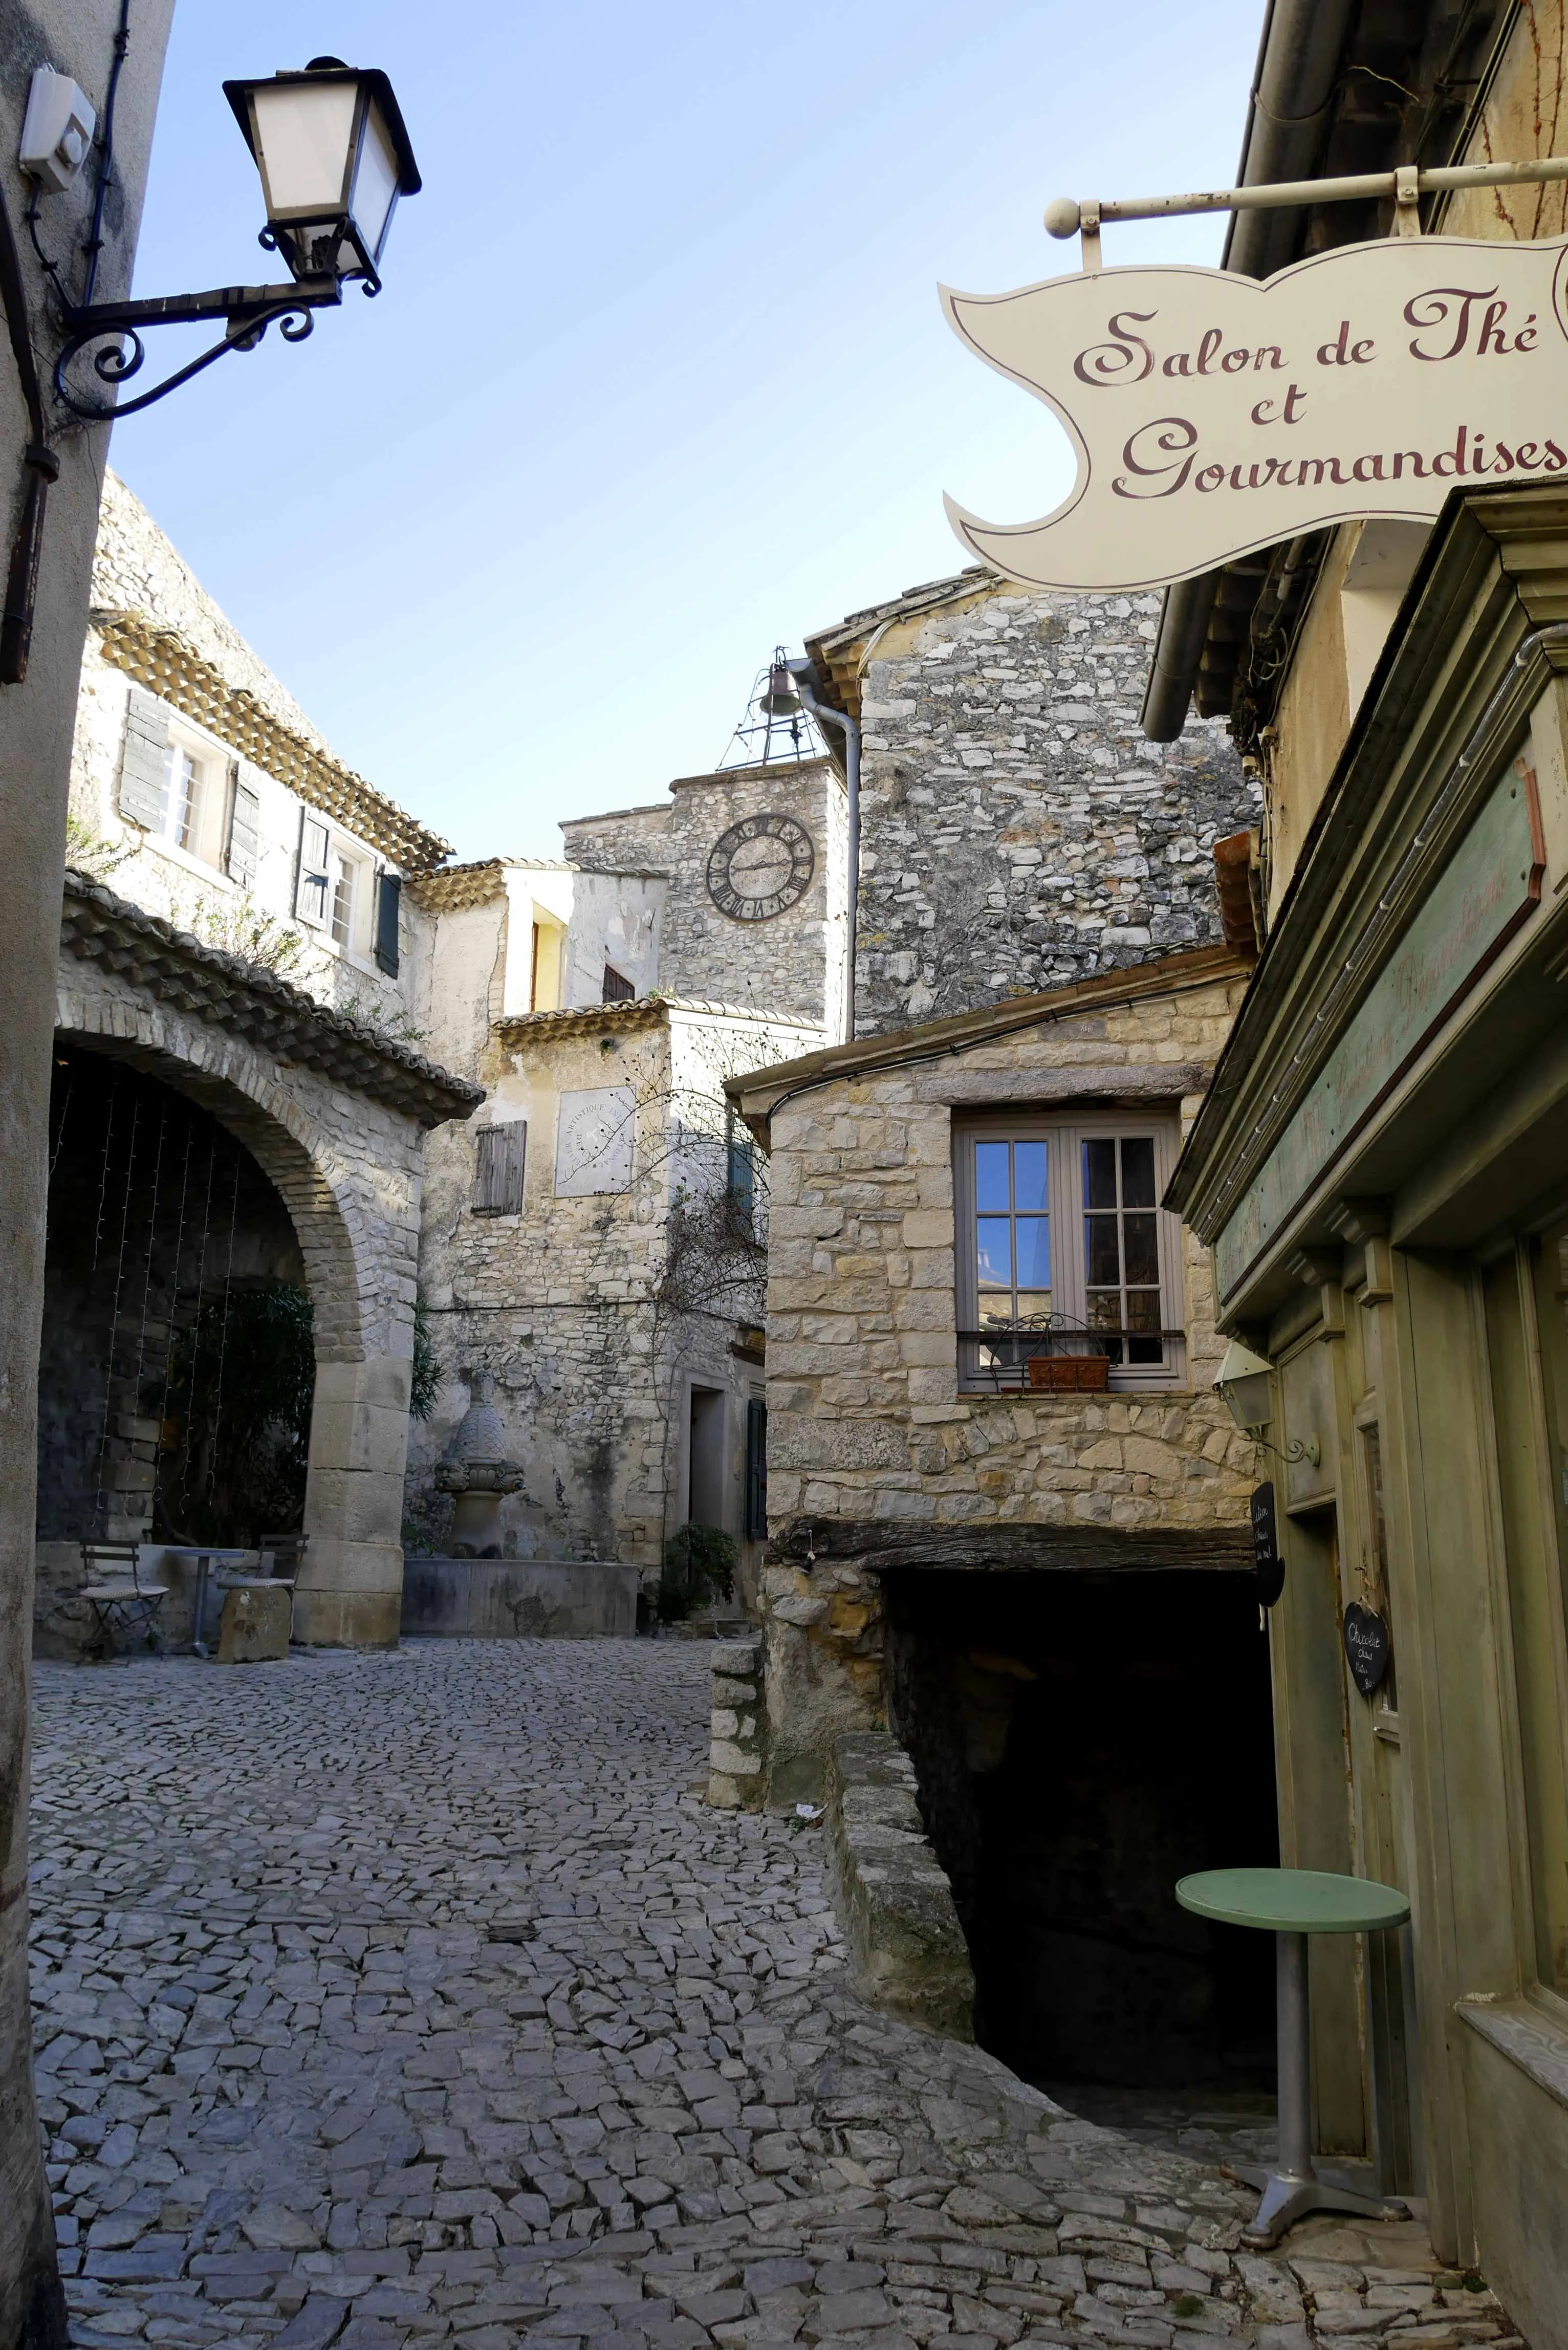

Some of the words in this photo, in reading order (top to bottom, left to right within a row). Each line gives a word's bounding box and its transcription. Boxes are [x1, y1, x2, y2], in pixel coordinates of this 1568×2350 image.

[1073, 309, 1289, 387] Salon
[1316, 320, 1378, 367] de
[1403, 285, 1539, 361] Thé
[1251, 384, 1308, 425] et
[1112, 417, 1567, 499] Gourmandises
[566, 1103, 606, 1136] ARTISTIQUE
[1348, 1623, 1380, 1648] Chocolat
